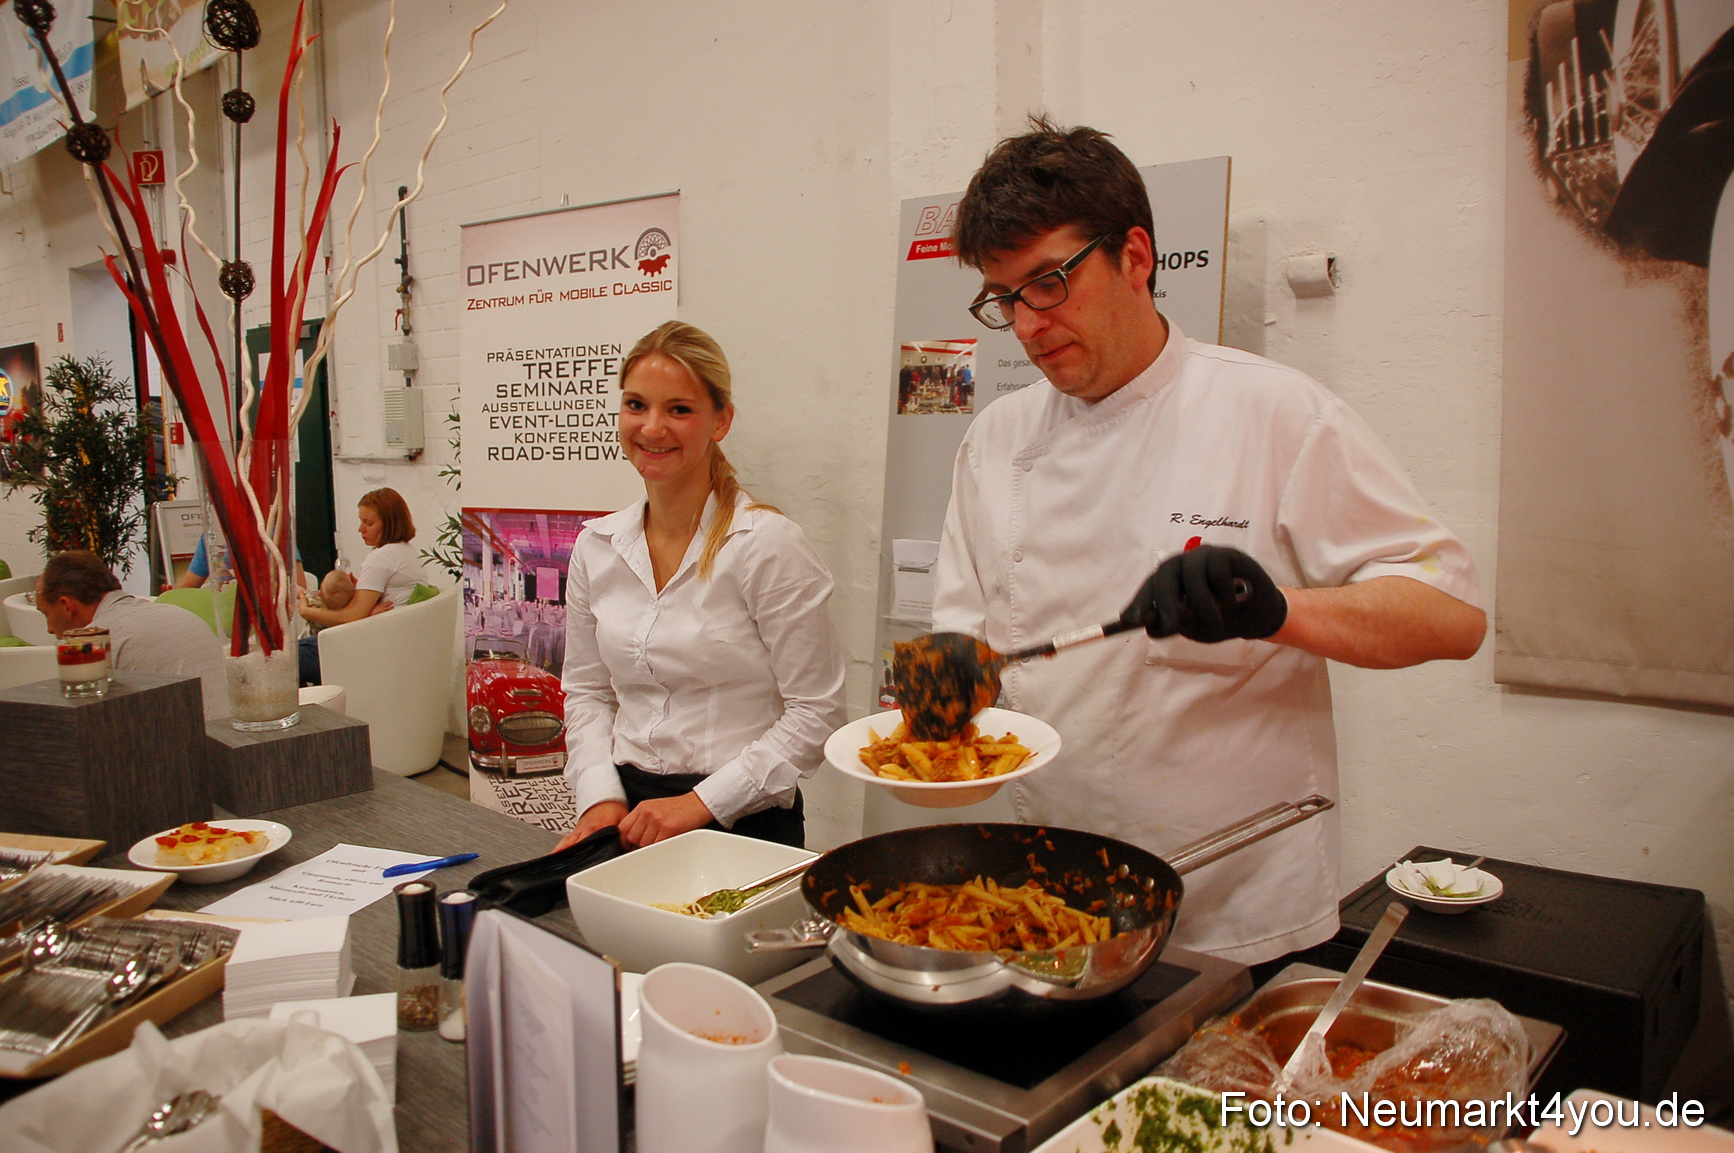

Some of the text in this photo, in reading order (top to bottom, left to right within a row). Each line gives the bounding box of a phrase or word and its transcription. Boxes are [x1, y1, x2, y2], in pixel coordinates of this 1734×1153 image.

[915, 202, 959, 236] BA
[916, 242, 952, 254] Feine Mo
[467, 245, 631, 286] OFENWERK
[1156, 249, 1209, 270] HOPS
[467, 280, 672, 310] ZENTRUM FÜR MOBILE CLASSIC
[1153, 289, 1167, 299] xis
[487, 343, 622, 363] PRÄSENTATIONEN
[522, 358, 619, 380] TREFFE
[998, 359, 1031, 369] Das gesa
[496, 378, 609, 398] SEMINARE
[481, 399, 606, 413] AUSSTELLUNGEN
[489, 413, 620, 430] EVENT-LOCAT
[487, 446, 621, 461] ROAD-SHOW
[1169, 512, 1250, 529] R. Engelhardt
[515, 781, 562, 831] SEMI
[527, 780, 574, 829] AUSSTE
